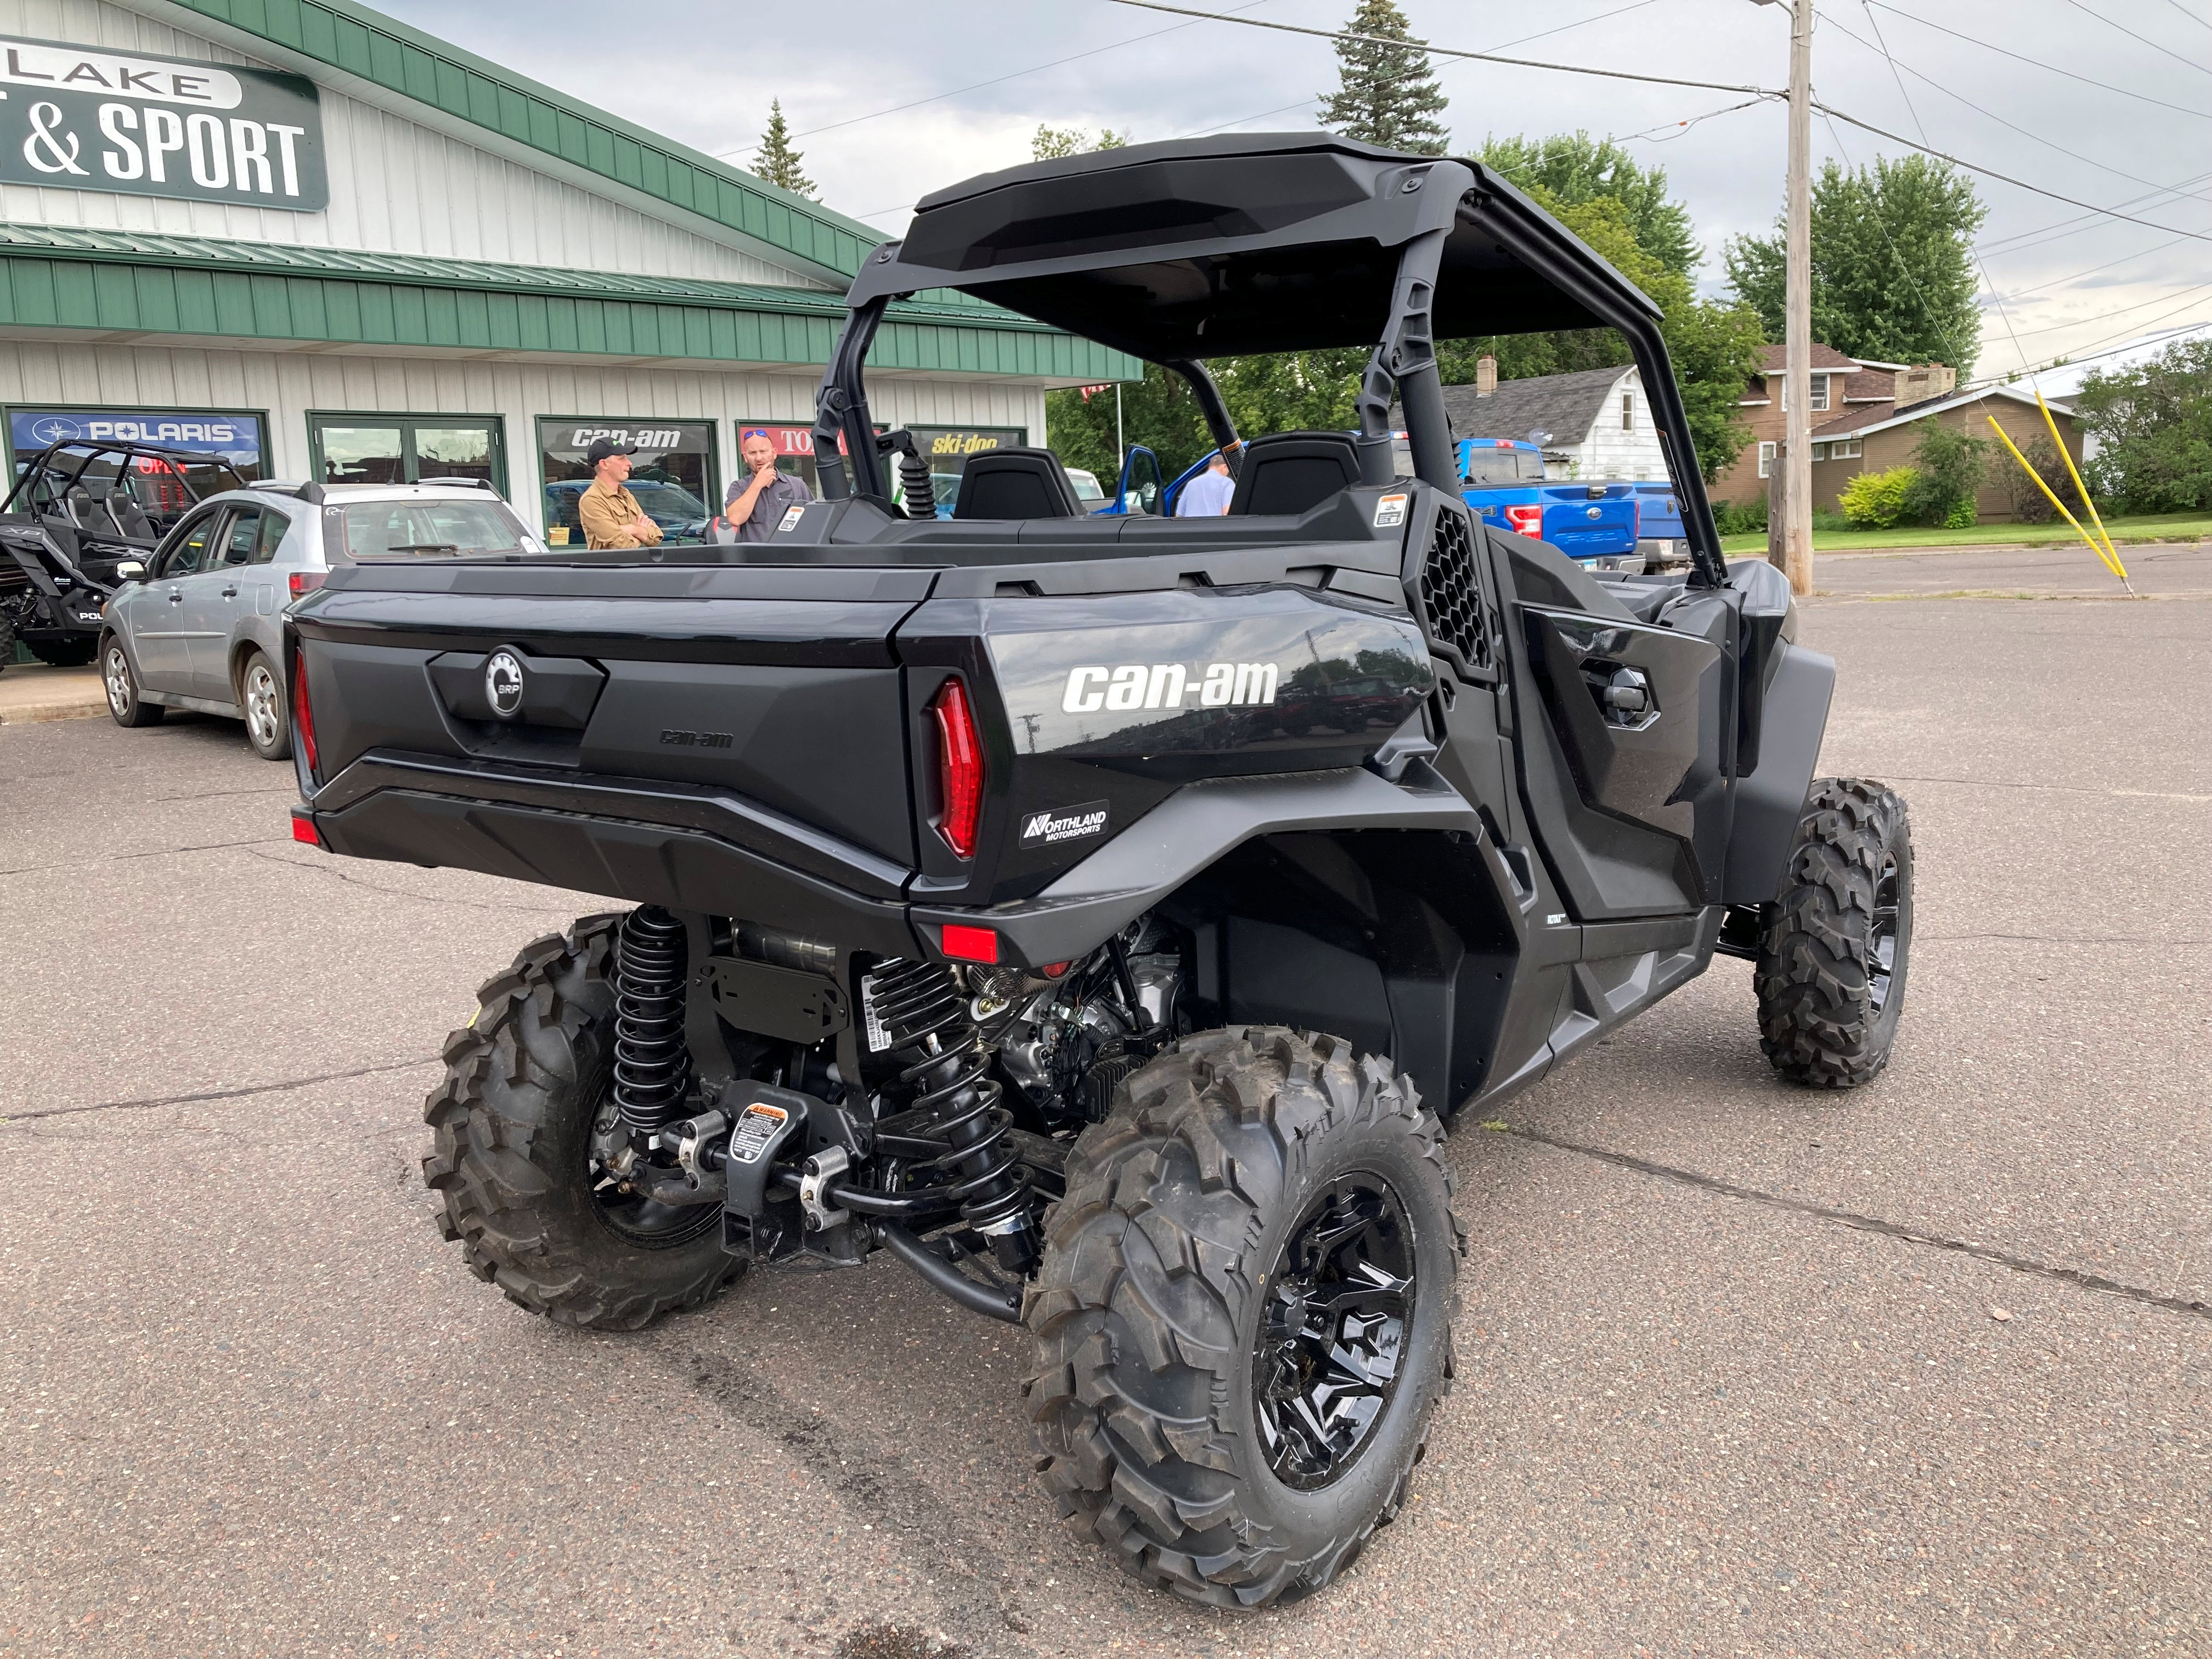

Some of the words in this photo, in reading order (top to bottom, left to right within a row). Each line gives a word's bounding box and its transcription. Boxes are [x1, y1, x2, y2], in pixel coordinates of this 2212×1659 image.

[7, 49, 212, 100] LAKE
[24, 101, 90, 176] &
[99, 103, 304, 197] SPORT
[89, 422, 233, 442] POLARIS
[498, 685, 520, 694] BRP
[1063, 663, 1279, 713] can-am
[1023, 811, 1106, 838] NORTHLAND
[1046, 825, 1101, 842] MOTORSPORTS
[759, 1108, 782, 1117] WARNING
